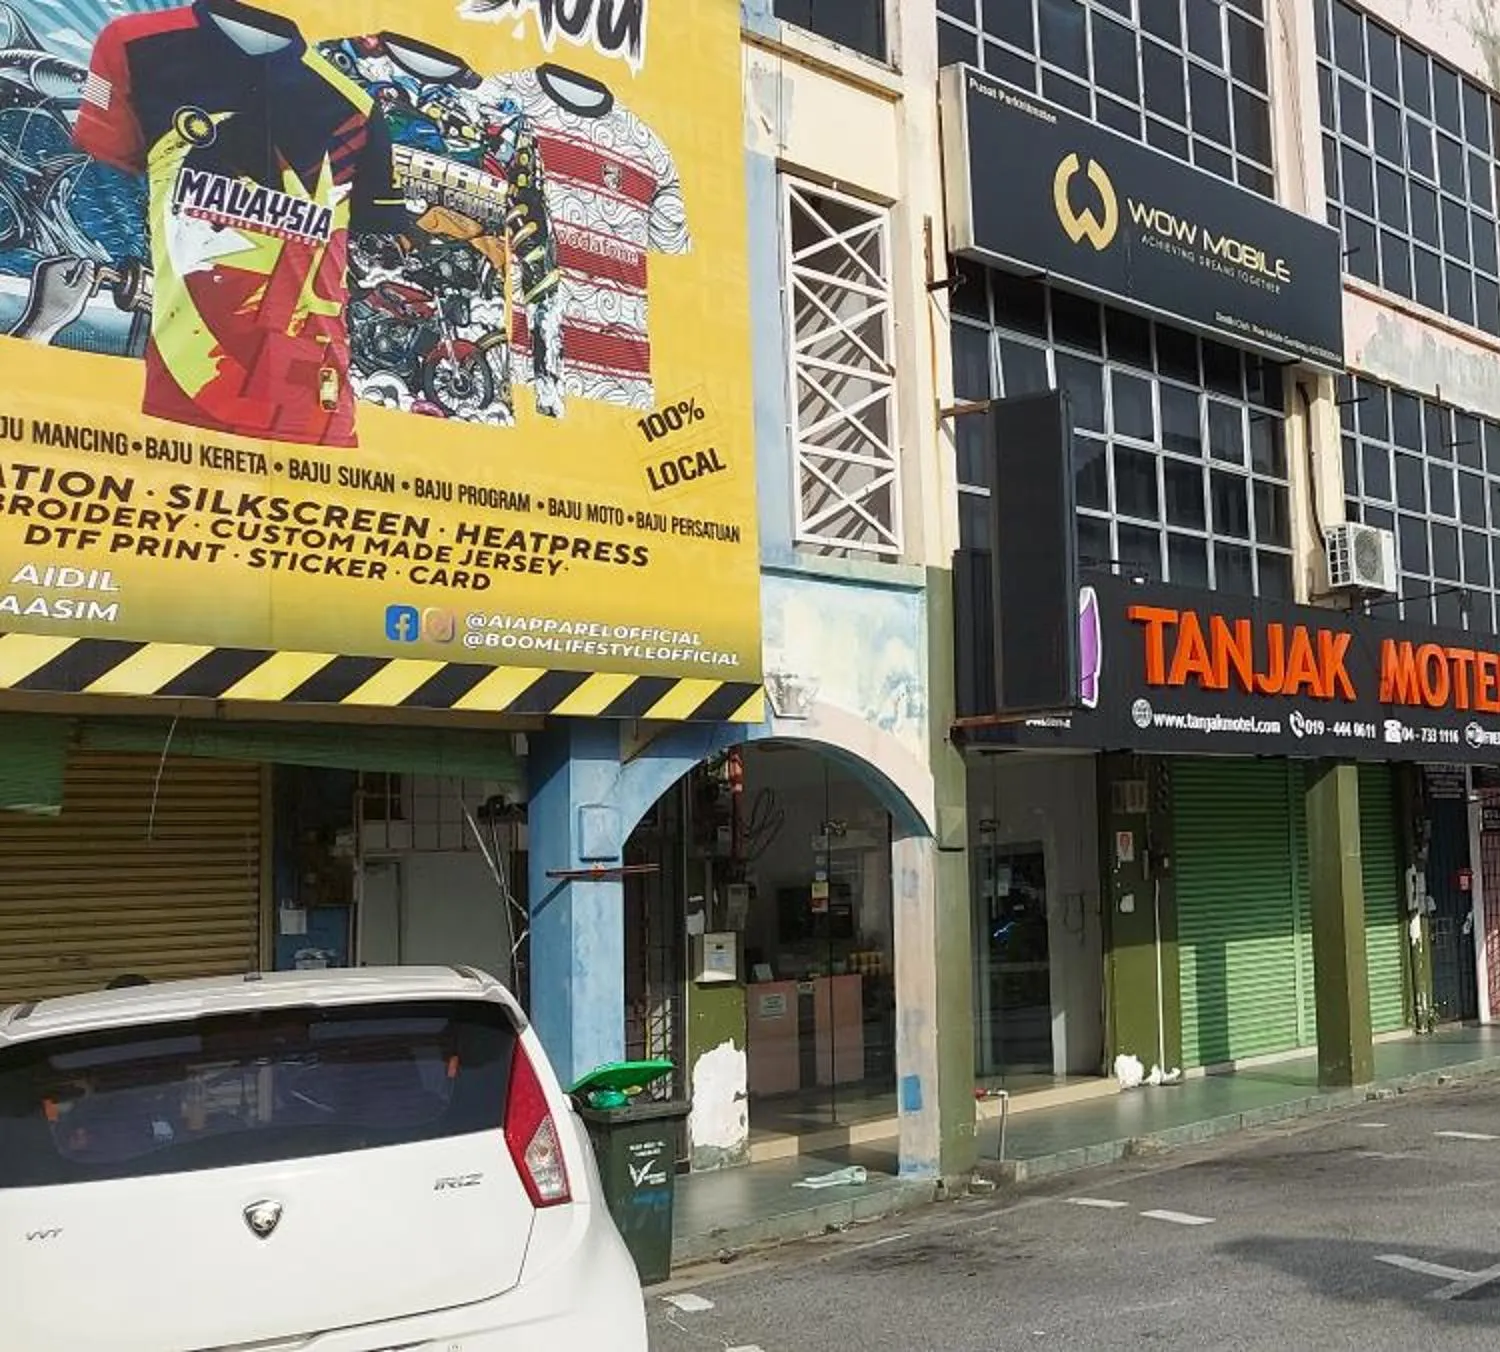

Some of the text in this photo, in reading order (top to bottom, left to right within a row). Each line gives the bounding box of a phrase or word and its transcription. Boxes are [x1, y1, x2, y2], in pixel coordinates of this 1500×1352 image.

[175, 168, 333, 242] MALAYSIA
[1127, 198, 1291, 283] WOW MOBILE
[637, 397, 706, 443] 100%
[32, 420, 128, 456] MANCING
[145, 436, 193, 464] BAJU
[200, 445, 267, 476] KERETA
[288, 457, 331, 485] BAJU
[338, 466, 395, 493] SUKAN
[415, 477, 452, 501] BAJU
[457, 484, 531, 513] PROGRAM
[547, 497, 581, 521] BAJU
[586, 502, 624, 527] MOTO
[635, 511, 668, 533] BAJU
[671, 517, 741, 544] PERSATUAN
[646, 448, 727, 492] LOCAL
[0, 494, 564, 577] ROIDERY CUSTOM MADE JERSEY
[24, 523, 491, 591] DTF PRINT STICKER CARD
[166, 484, 430, 539] SILKSCREEN
[455, 522, 650, 567] HEATPRESS
[11, 563, 121, 593] AIDIL
[1127, 604, 1358, 703] TANJAK
[1153, 712, 1281, 734] www.tanjakmotel.com
